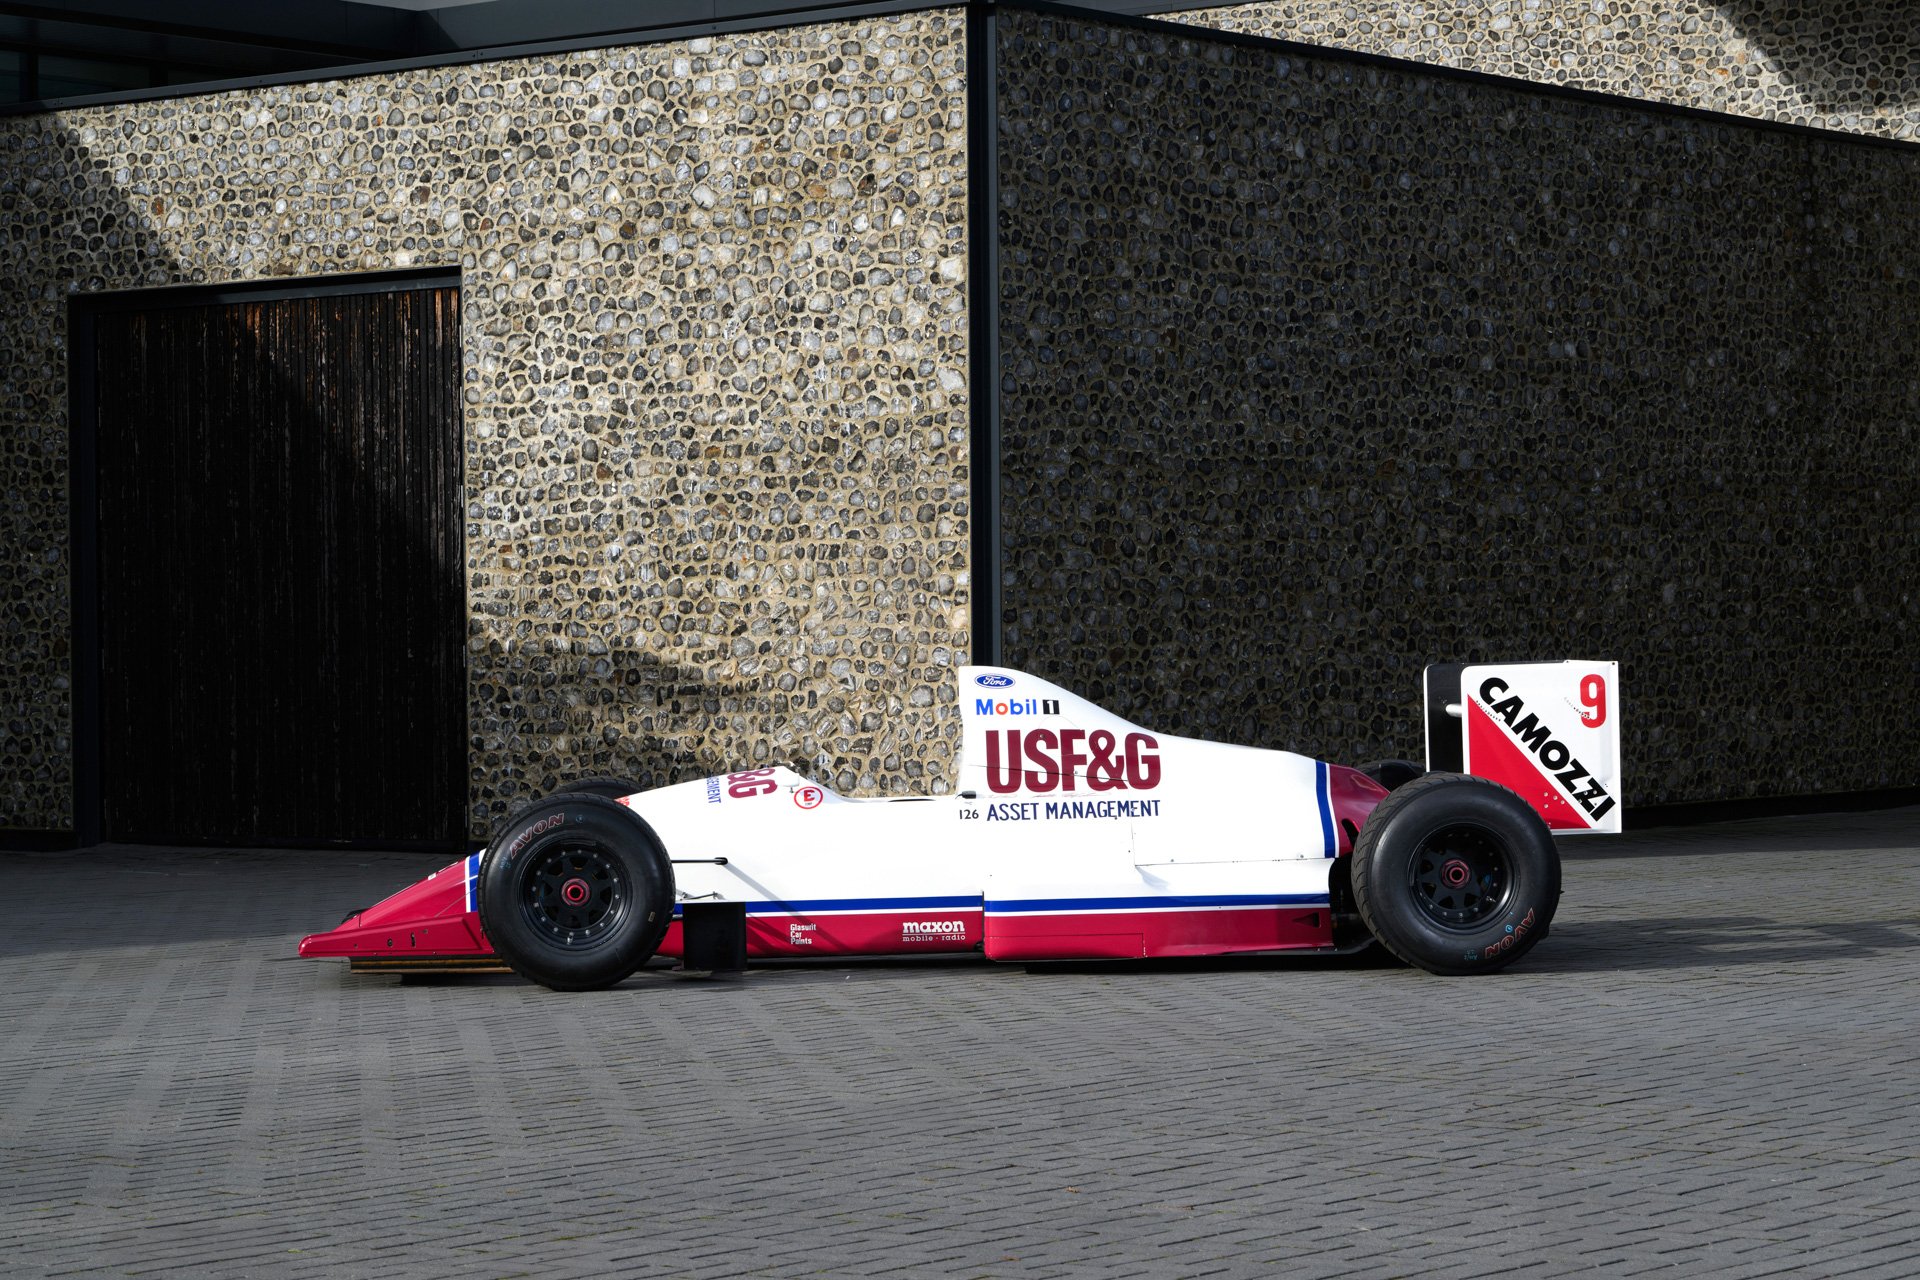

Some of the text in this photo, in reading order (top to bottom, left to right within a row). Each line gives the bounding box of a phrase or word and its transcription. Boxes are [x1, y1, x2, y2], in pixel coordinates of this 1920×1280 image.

[983, 675, 1007, 686] Ford
[975, 698, 1037, 716] Mobil
[1580, 673, 1606, 729] 9
[1479, 677, 1617, 822] CAMOZZI
[985, 728, 1162, 794] USF&G
[803, 789, 816, 802] E
[959, 809, 979, 820] 126
[987, 800, 1161, 822] ASSET MANAGEMENT
[509, 813, 565, 860] AVON
[790, 923, 817, 931] Glasurit
[790, 930, 803, 938] Car
[902, 920, 966, 934] maxon
[1484, 907, 1536, 959] AVON
[790, 937, 813, 945] Paints
